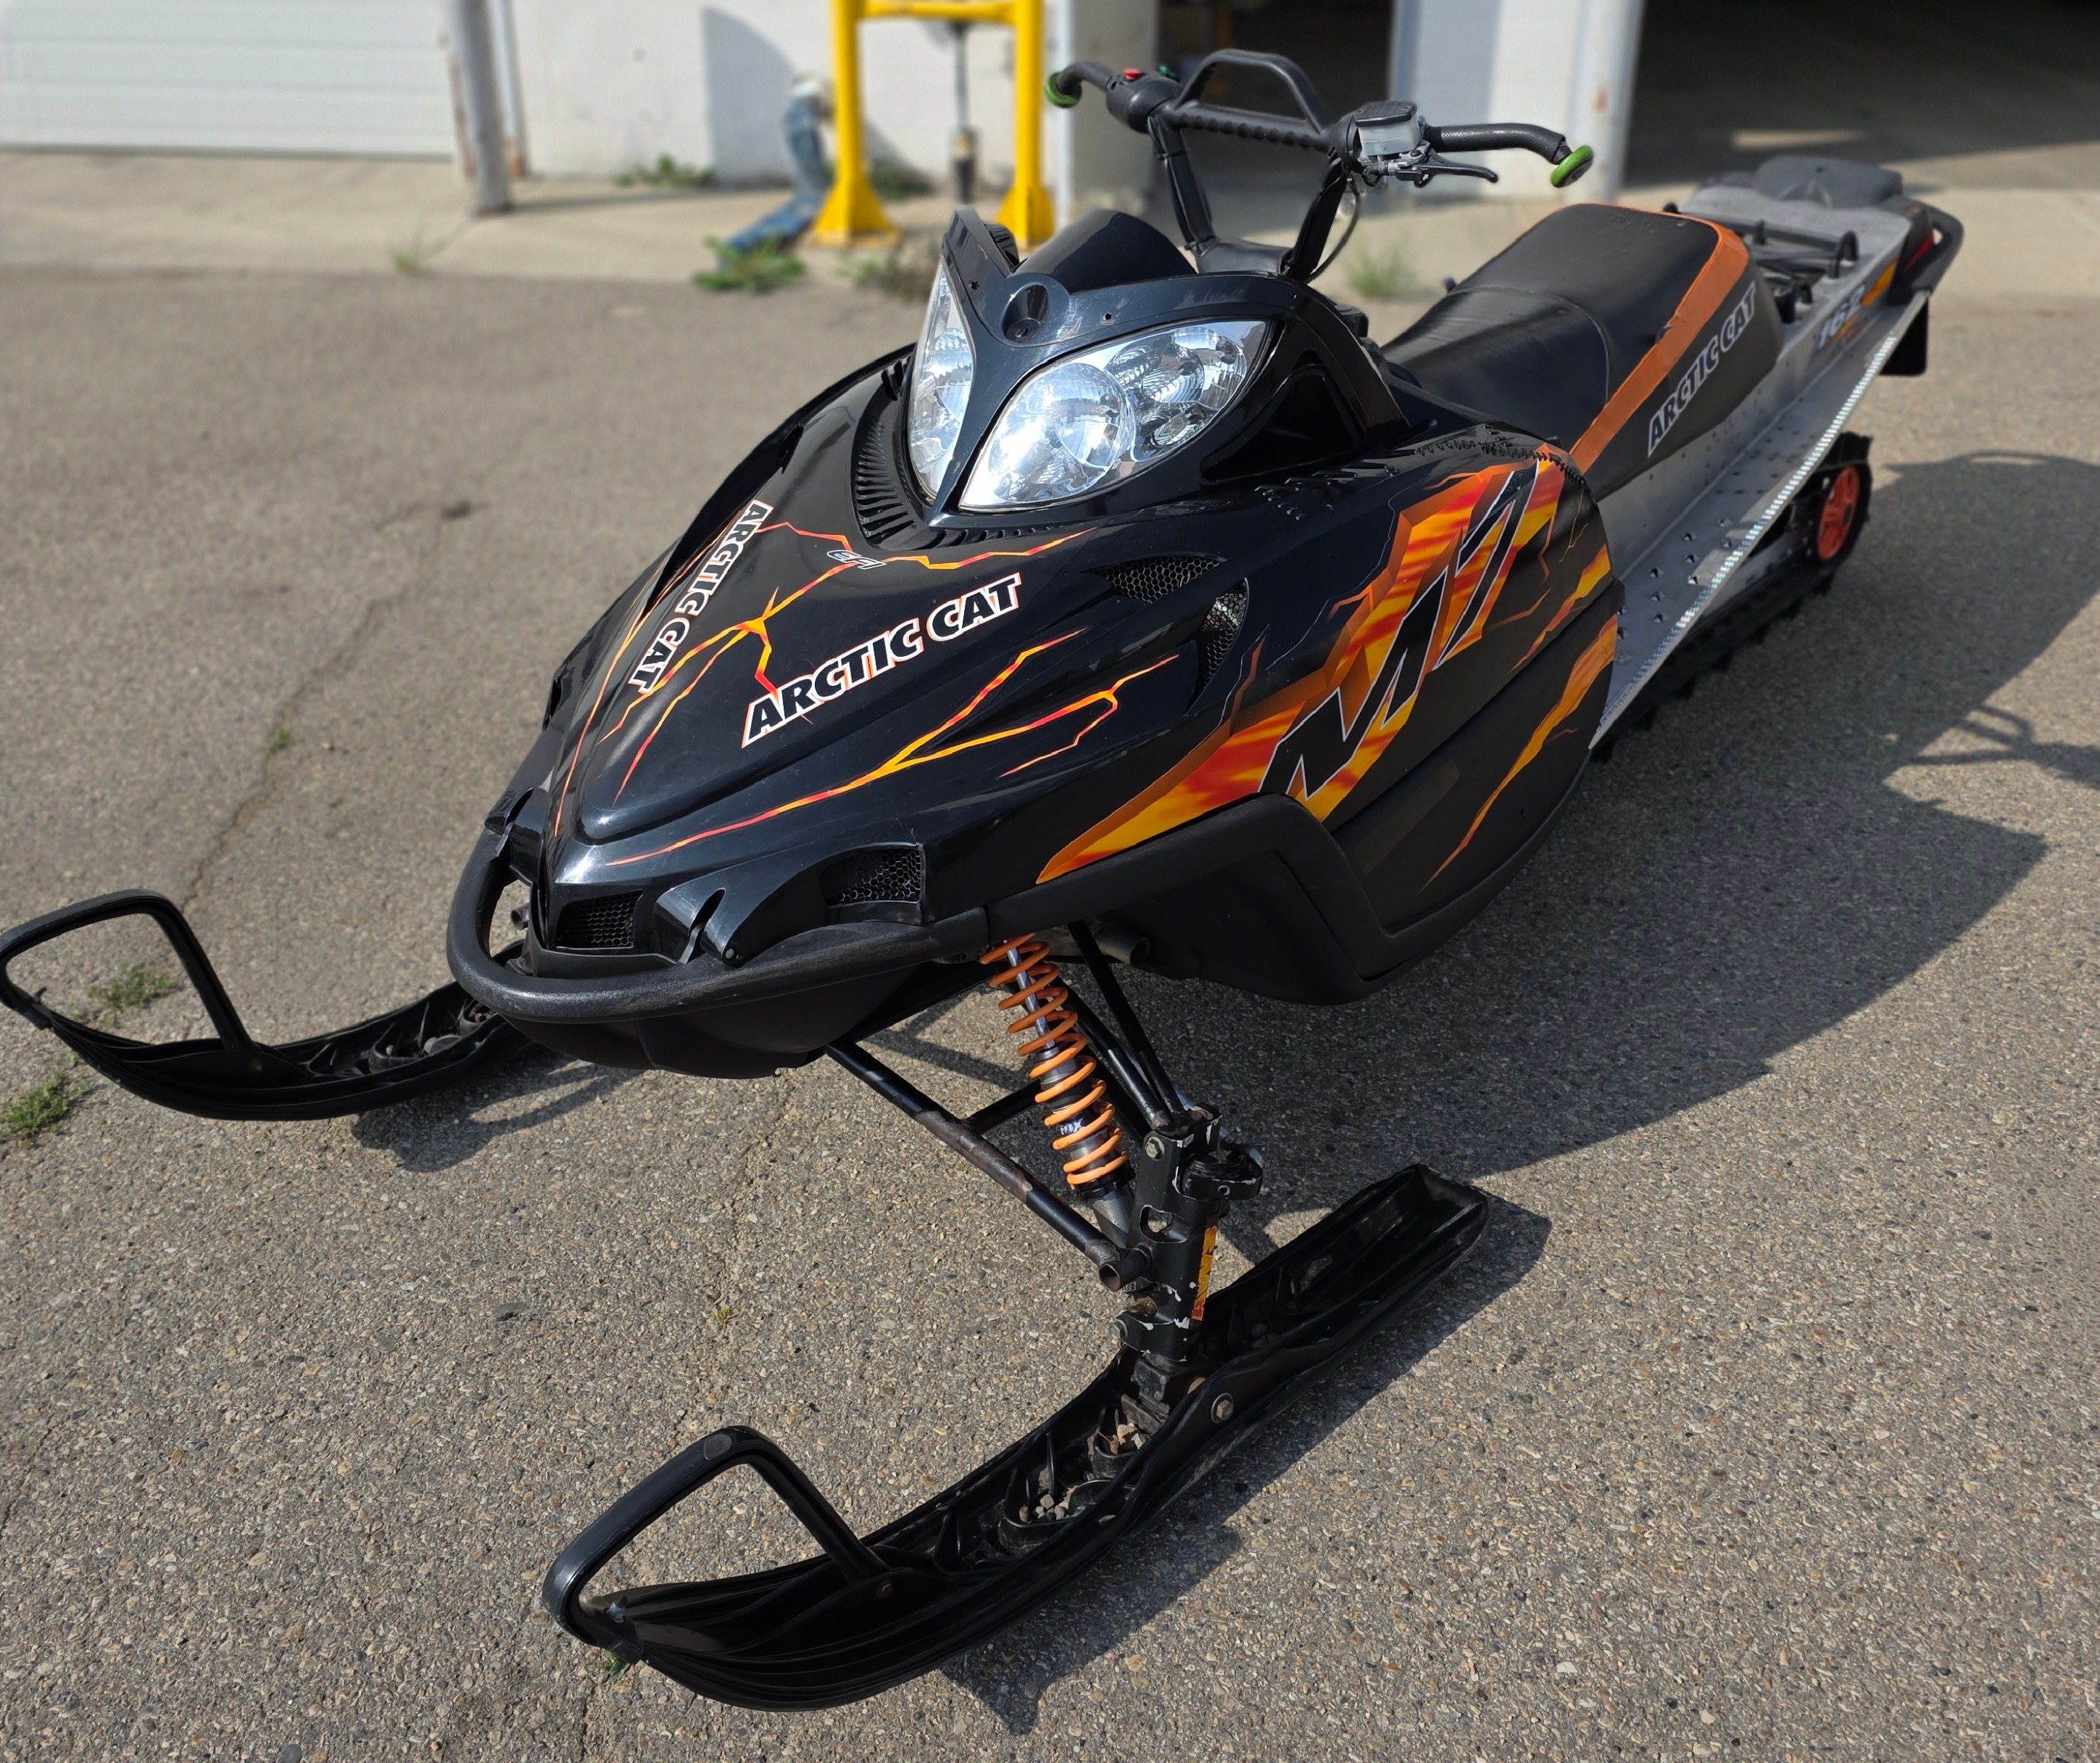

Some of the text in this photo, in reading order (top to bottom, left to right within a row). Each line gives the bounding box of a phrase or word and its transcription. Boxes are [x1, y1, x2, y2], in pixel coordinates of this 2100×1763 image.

[1648, 281, 1756, 458] ARCTIC CAT
[1817, 284, 1865, 349] 162
[628, 499, 774, 694] ARCTIC CAT
[741, 572, 1022, 748] ARCTIC CAT
